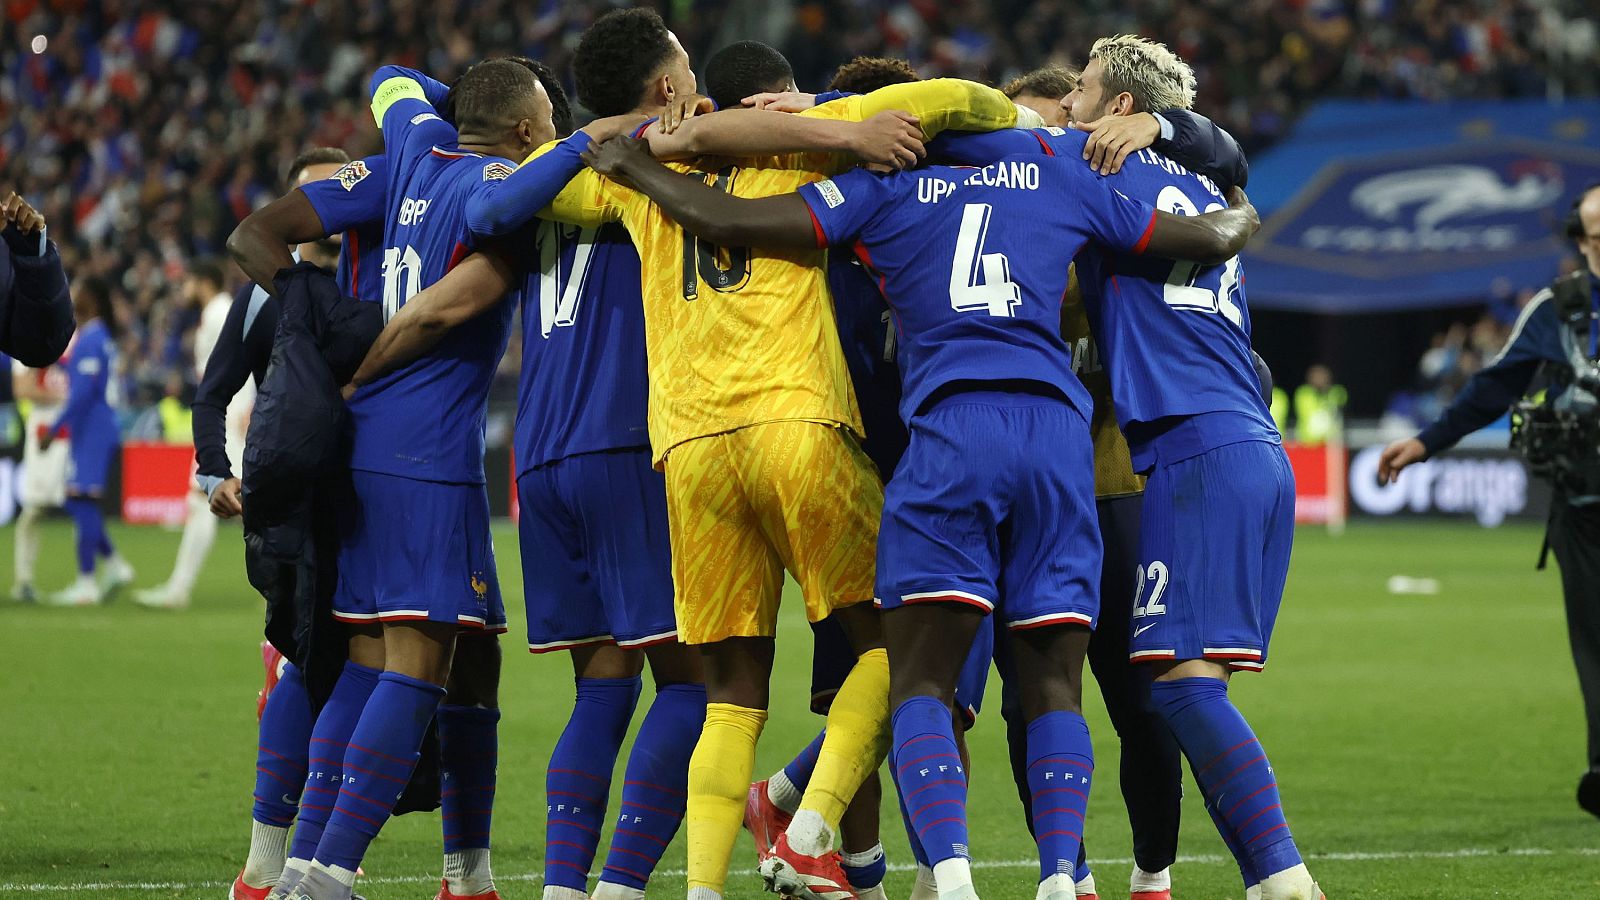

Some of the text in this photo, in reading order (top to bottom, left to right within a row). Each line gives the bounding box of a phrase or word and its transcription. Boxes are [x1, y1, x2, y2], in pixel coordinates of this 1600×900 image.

[949, 203, 1022, 318] 4
[1351, 446, 1528, 528] Orange
[1132, 560, 1169, 618] 22
